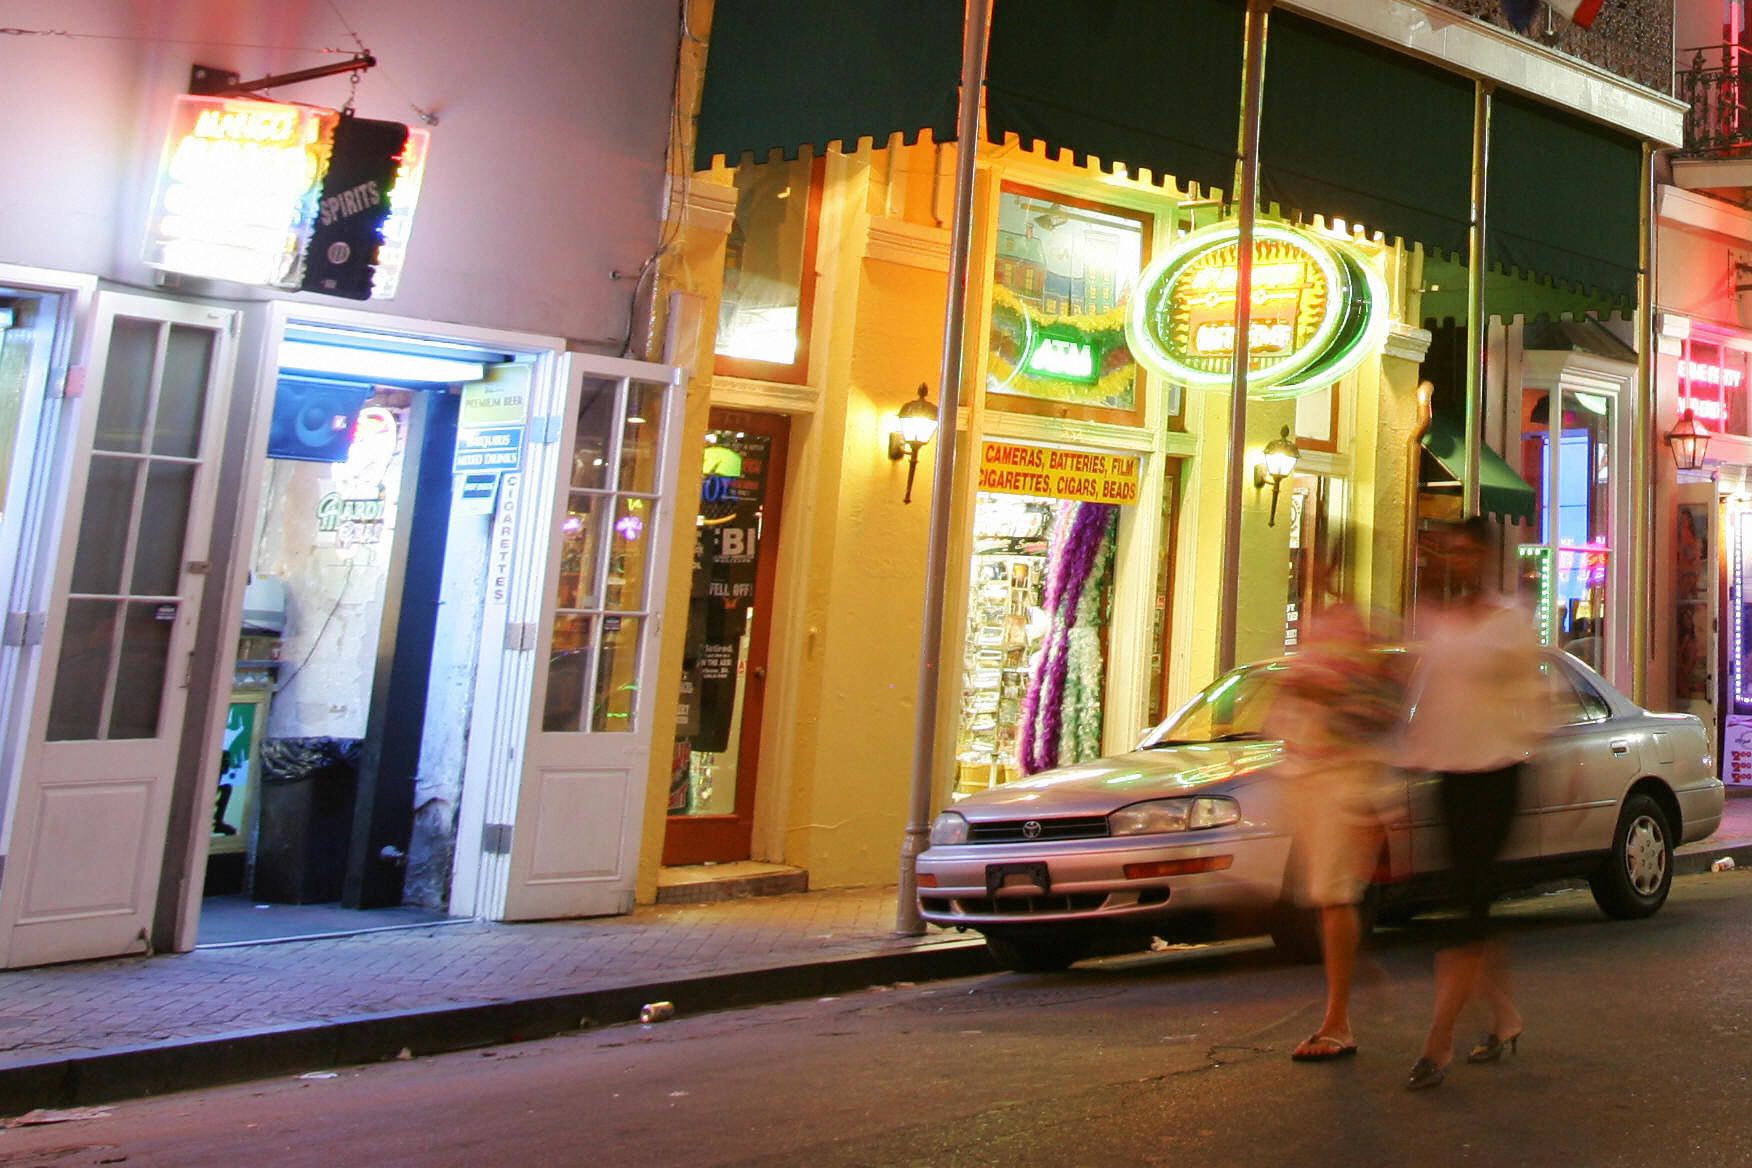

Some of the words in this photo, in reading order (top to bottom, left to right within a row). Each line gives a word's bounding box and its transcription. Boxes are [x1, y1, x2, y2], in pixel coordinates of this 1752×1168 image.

[321, 180, 380, 226] SPIRITS
[1030, 337, 1093, 378] ATM
[985, 445, 1045, 471] CAMERAS,
[1050, 451, 1108, 475] BATTERIES,
[1112, 458, 1134, 476] FILM
[978, 469, 1051, 496] CIGARETTES,
[1057, 476, 1098, 499] CIGARS,
[1102, 481, 1136, 500] BEADS
[494, 476, 517, 600] CIGARETTES
